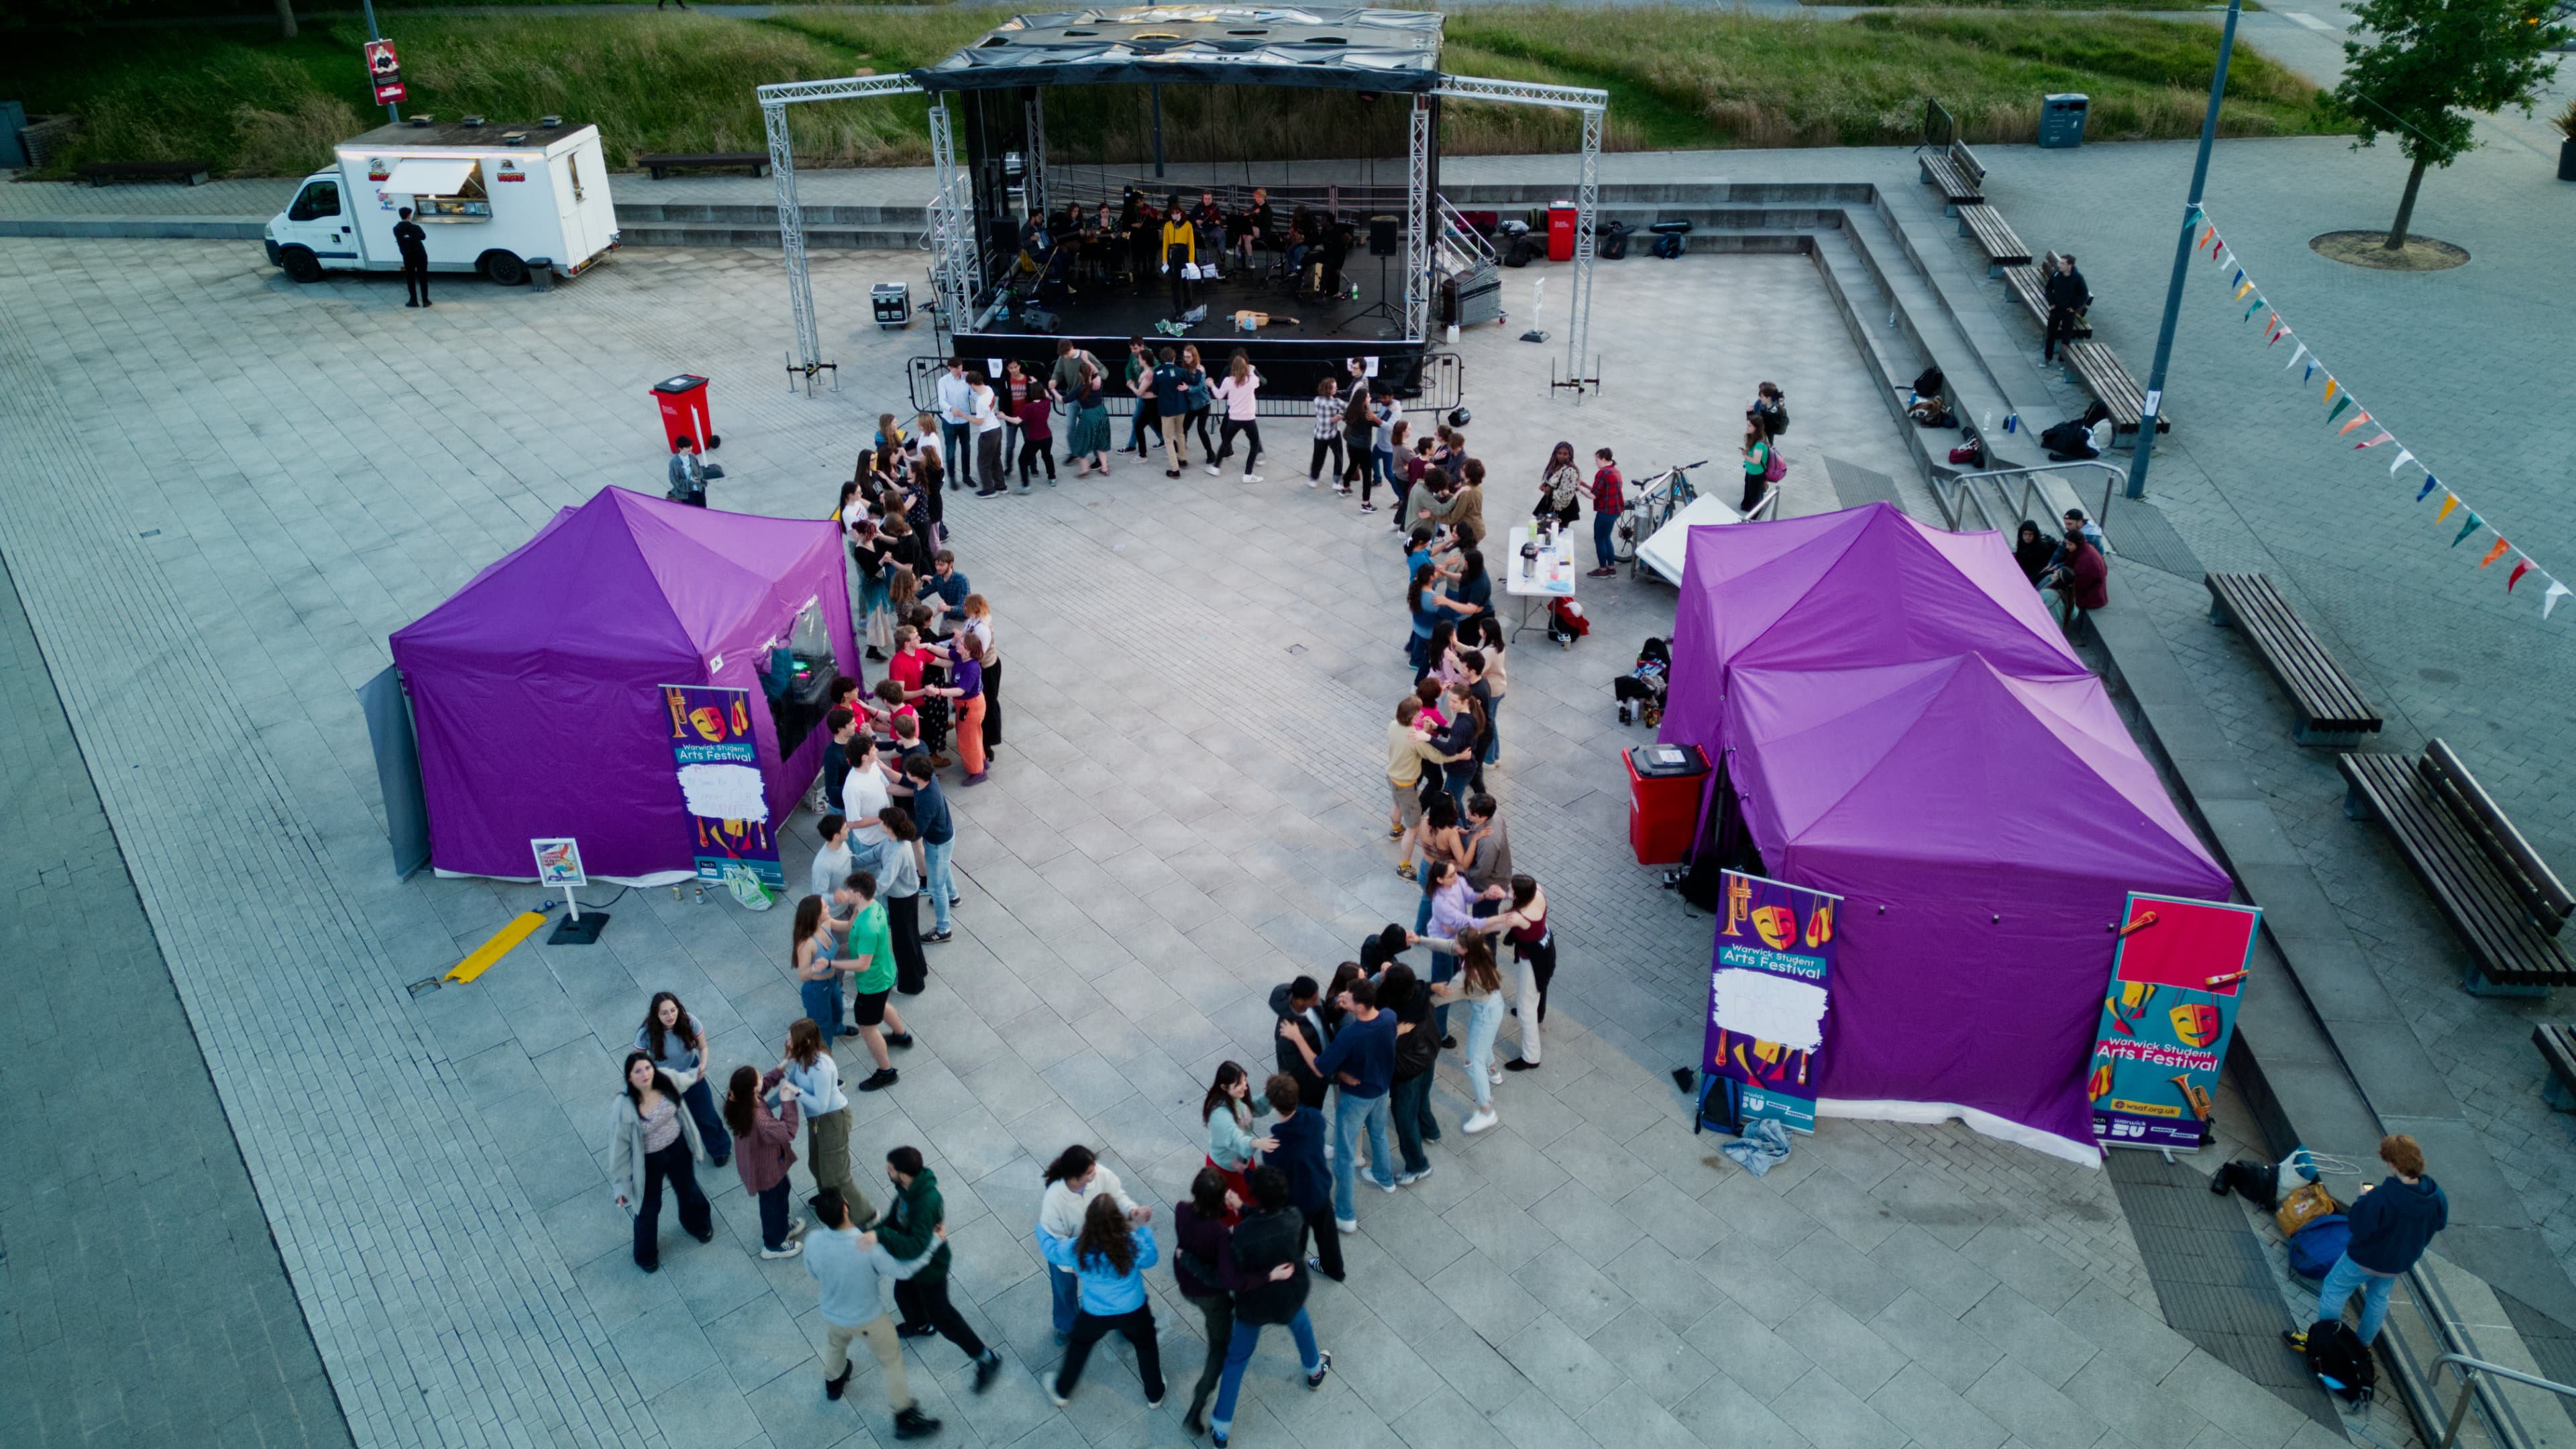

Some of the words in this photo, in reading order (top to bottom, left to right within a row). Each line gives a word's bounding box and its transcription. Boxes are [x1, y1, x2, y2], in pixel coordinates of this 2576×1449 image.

[497, 172, 526, 182] BURGERS
[680, 751, 704, 759] Arts
[706, 751, 751, 762] Festival
[1732, 943, 1774, 958] Warwick
[1776, 953, 1815, 967] Student
[1724, 950, 1756, 965] Arts
[1760, 957, 1821, 979] Festival
[2109, 1036, 2160, 1051] Warwick
[2163, 1044, 2212, 1059] Student
[2097, 1045, 2135, 1060] Arts
[2141, 1050, 2218, 1072] Festival
[1743, 1091, 1764, 1100] rwick
[2126, 1104, 2176, 1114] wsaf.org.uk
[2114, 1118, 2147, 1126] warwick
